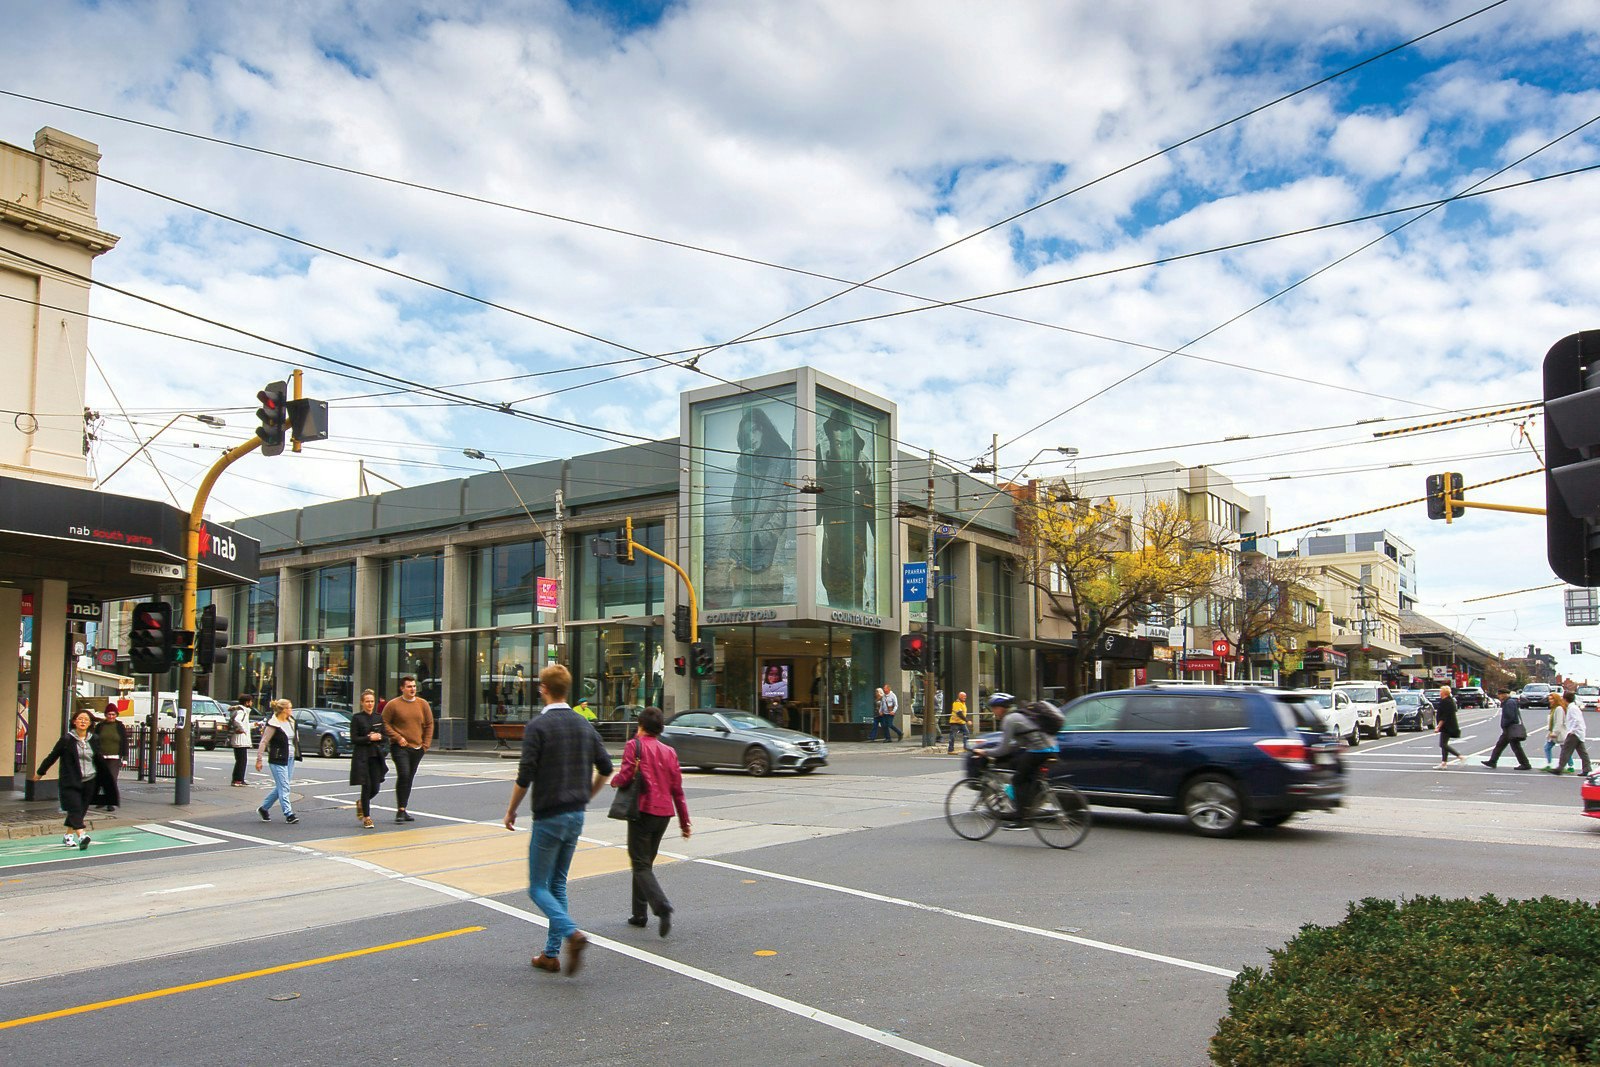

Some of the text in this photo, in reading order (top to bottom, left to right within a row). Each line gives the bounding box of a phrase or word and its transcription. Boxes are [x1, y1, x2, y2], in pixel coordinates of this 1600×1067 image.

[69, 525, 153, 545] nab south yarra
[212, 535, 237, 561] nab
[132, 561, 164, 574] TOORAK
[73, 602, 100, 616] nab
[706, 609, 777, 623] COUNTRY ROAD
[832, 610, 882, 627] COUNTRY ROAD
[1217, 644, 1227, 652] 40
[102, 651, 113, 661] 40
